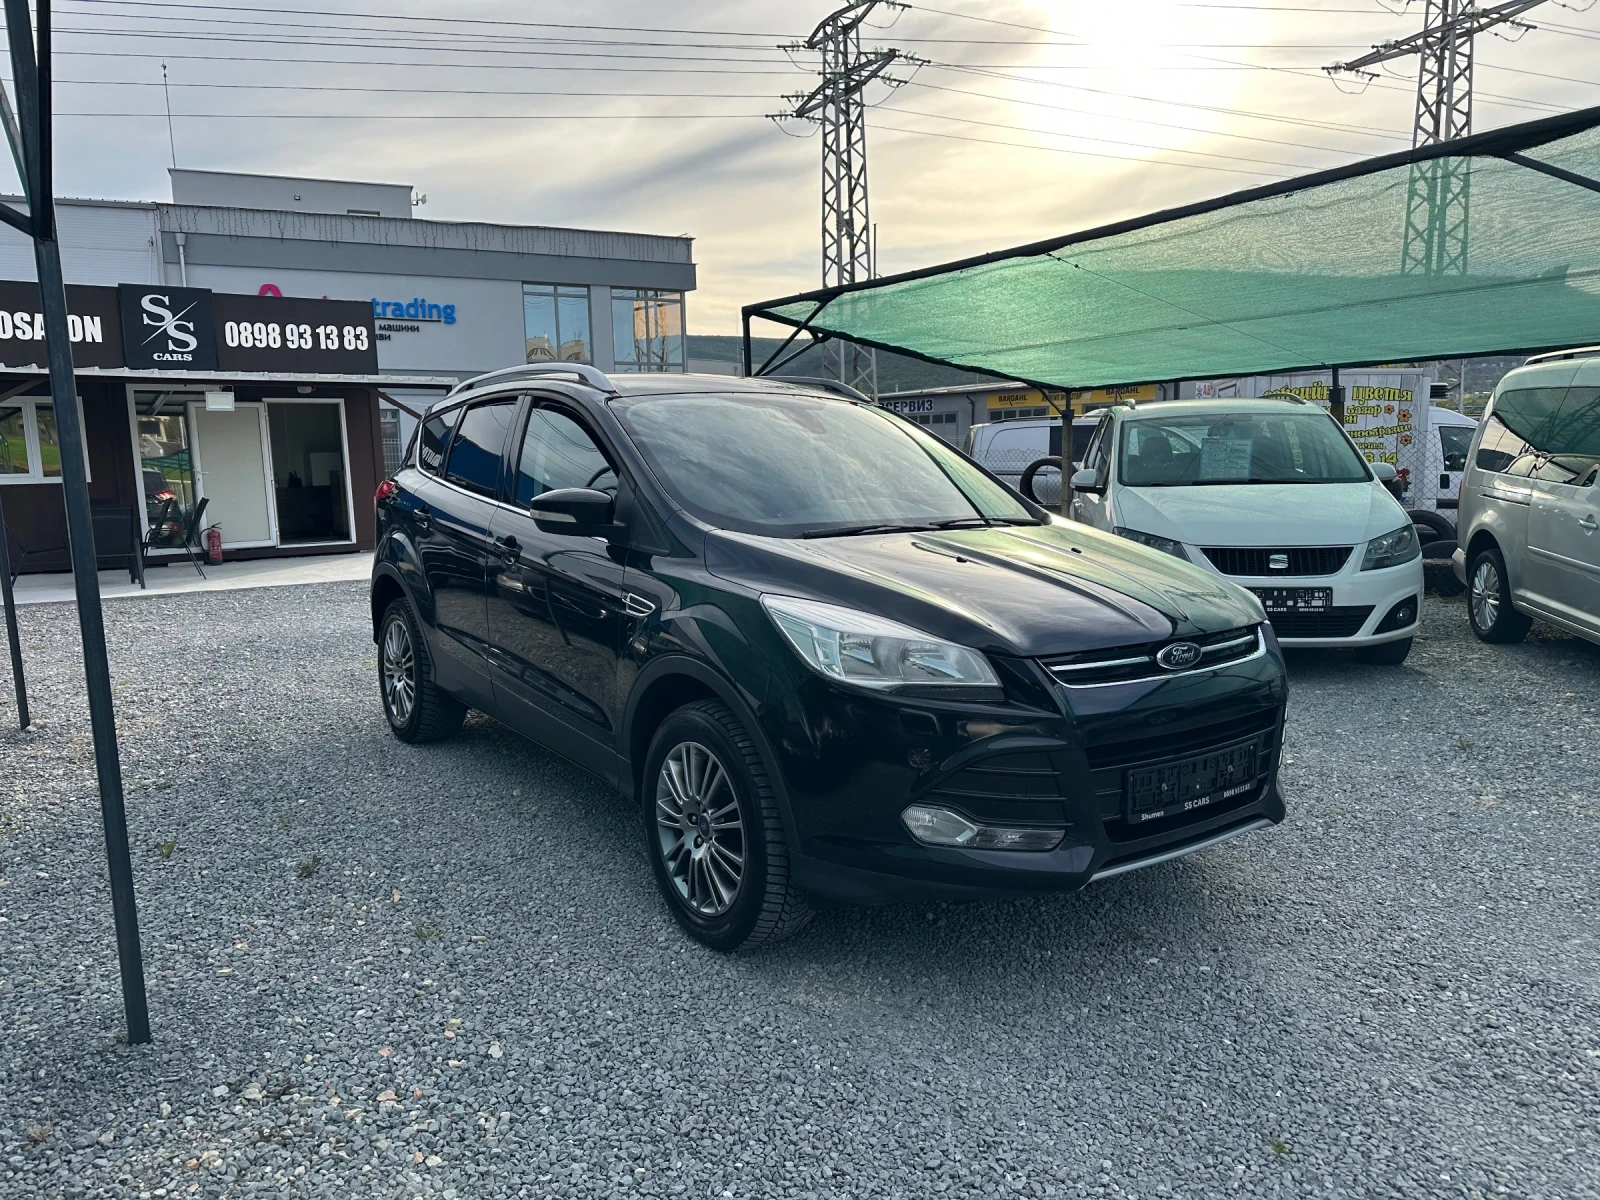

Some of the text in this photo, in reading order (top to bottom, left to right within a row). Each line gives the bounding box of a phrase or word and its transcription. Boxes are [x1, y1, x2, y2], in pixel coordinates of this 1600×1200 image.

[371, 298, 456, 324] trading
[0, 311, 103, 343] OSAON
[225, 321, 368, 350] 0898 93 13 83
[378, 323, 420, 333] машини
[153, 353, 193, 361] CARS
[998, 394, 1028, 406] BARDAHL
[1105, 386, 1140, 400] BARDAHL
[1171, 646, 1195, 664] Ford
[1140, 810, 1165, 821] Shumen
[1193, 796, 1210, 808] CARS
